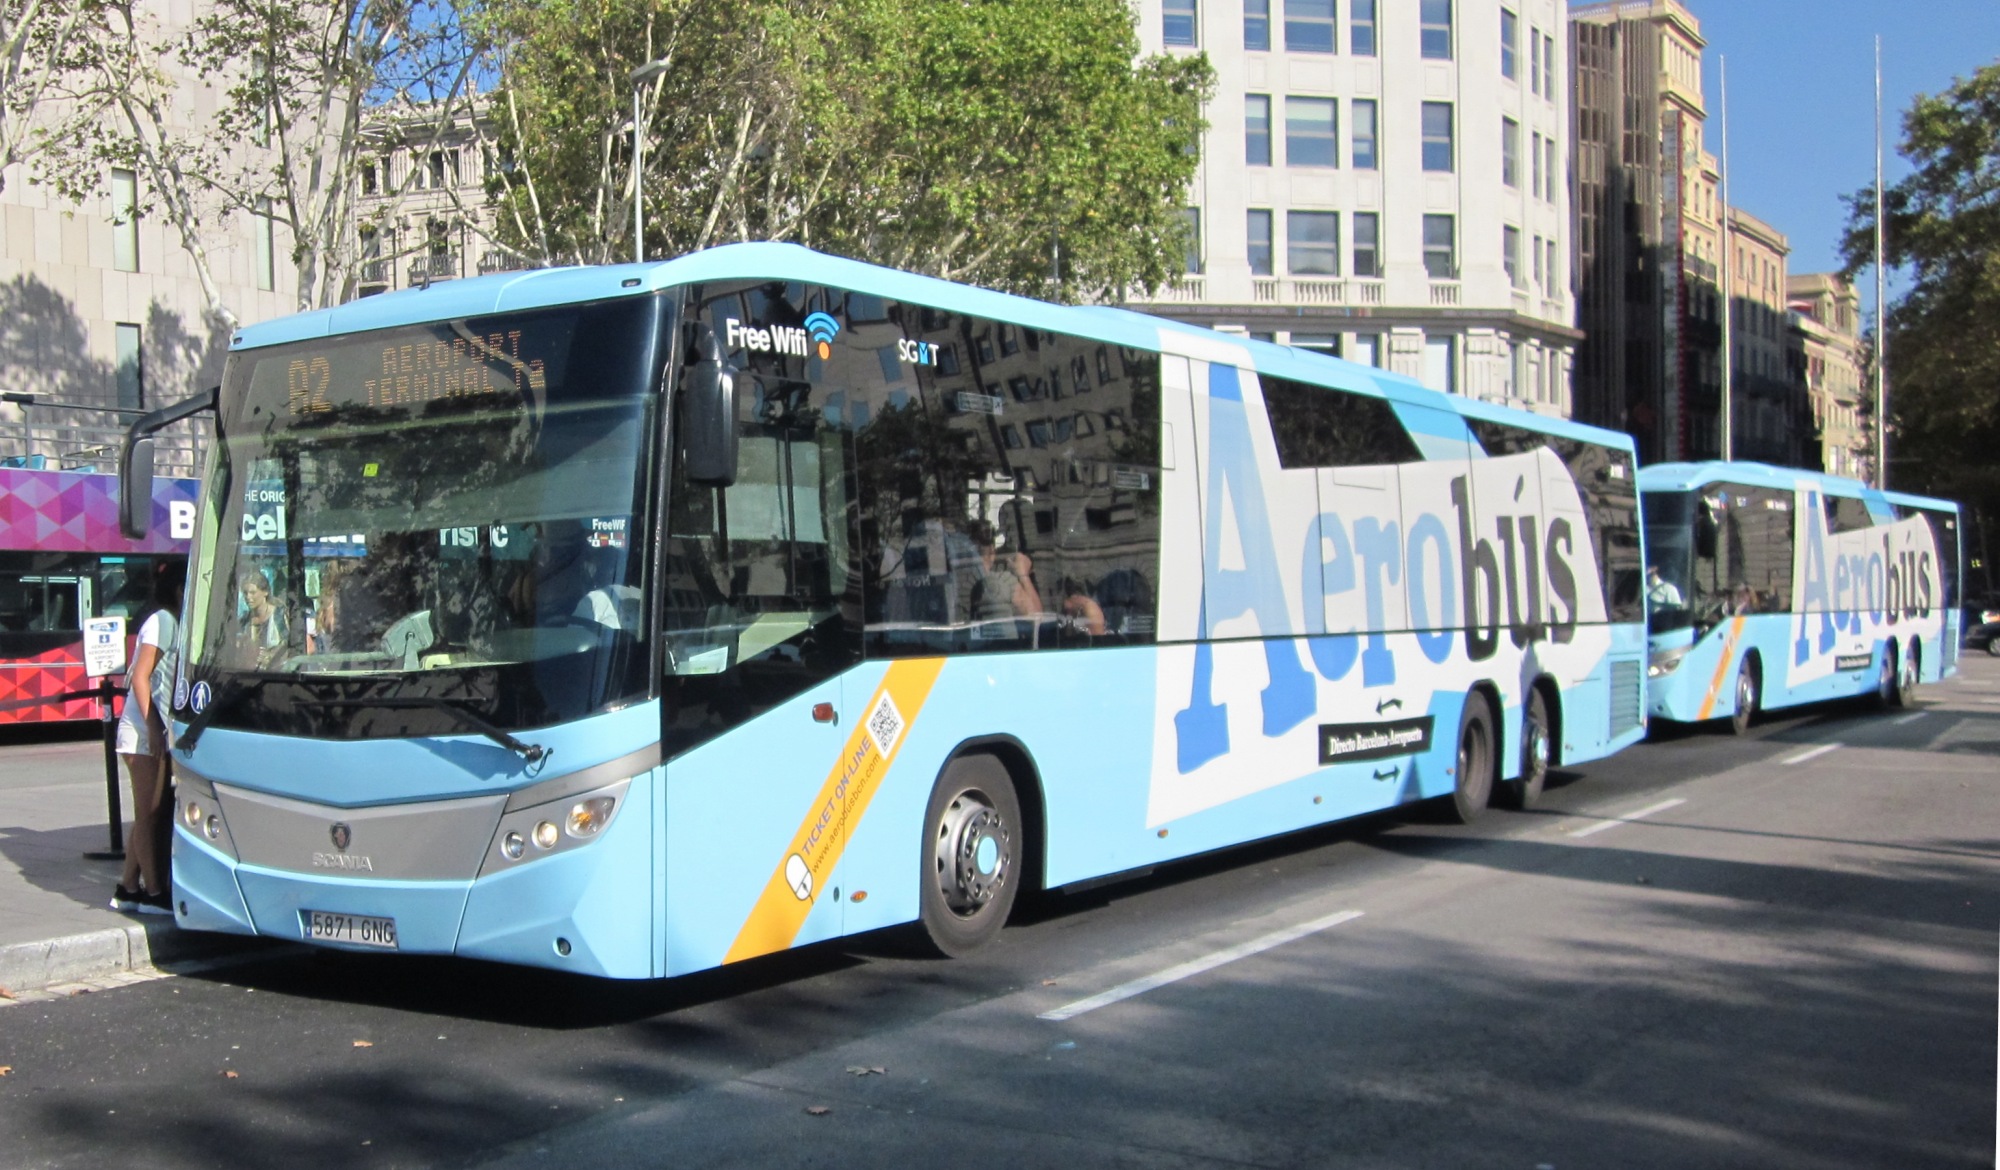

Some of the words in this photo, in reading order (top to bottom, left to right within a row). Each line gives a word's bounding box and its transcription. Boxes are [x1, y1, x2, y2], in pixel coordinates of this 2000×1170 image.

[382, 330, 521, 375] AEROPORT
[725, 317, 771, 351] Free
[770, 324, 808, 357] Wifi
[288, 357, 331, 416] A2
[365, 365, 494, 407] TERMINAL
[512, 359, 545, 390] T2
[1174, 362, 1578, 775] Aerobús
[1795, 490, 1931, 668] Aerobús
[801, 797, 835, 856] TICKET
[834, 735, 872, 801] ON-LINE
[812, 753, 881, 874] www.aerobusbcn.com
[312, 852, 373, 871] SCANIA
[313, 914, 353, 940] 5871
[361, 919, 395, 943] GNG
